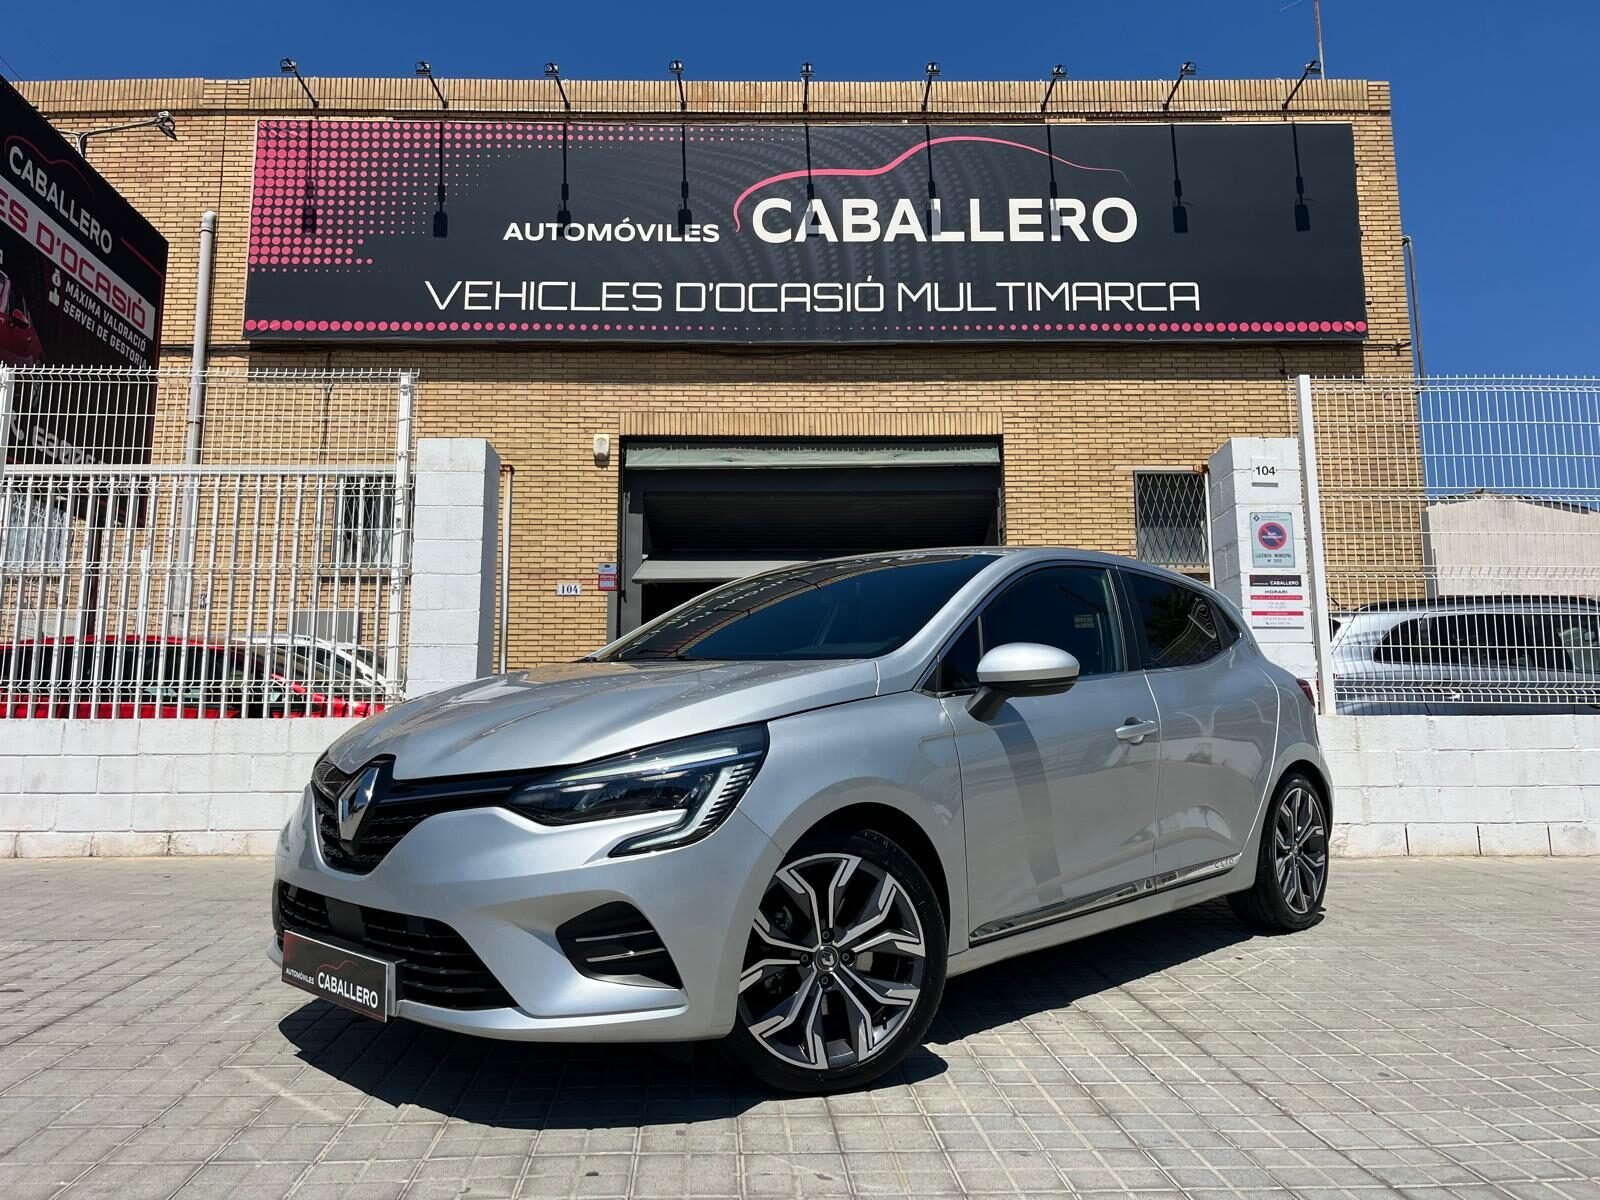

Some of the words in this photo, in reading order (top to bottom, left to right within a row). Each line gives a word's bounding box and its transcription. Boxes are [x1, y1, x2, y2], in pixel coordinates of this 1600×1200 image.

[9, 145, 113, 254] CABALLERO
[503, 217, 720, 243] AUTOMÓVILES
[752, 197, 1138, 243] CABALLERO
[35, 220, 146, 330] D'OCASIÓ
[425, 280, 662, 312] VEHICLES
[675, 275, 884, 313] D'OCASIÓ
[897, 281, 1201, 313] MULTIMARCA
[63, 299, 95, 332] SERVEI
[96, 324, 109, 342] DE
[1255, 465, 1276, 476] 104
[561, 585, 578, 594] 104
[317, 972, 379, 1009] CABALLERO
